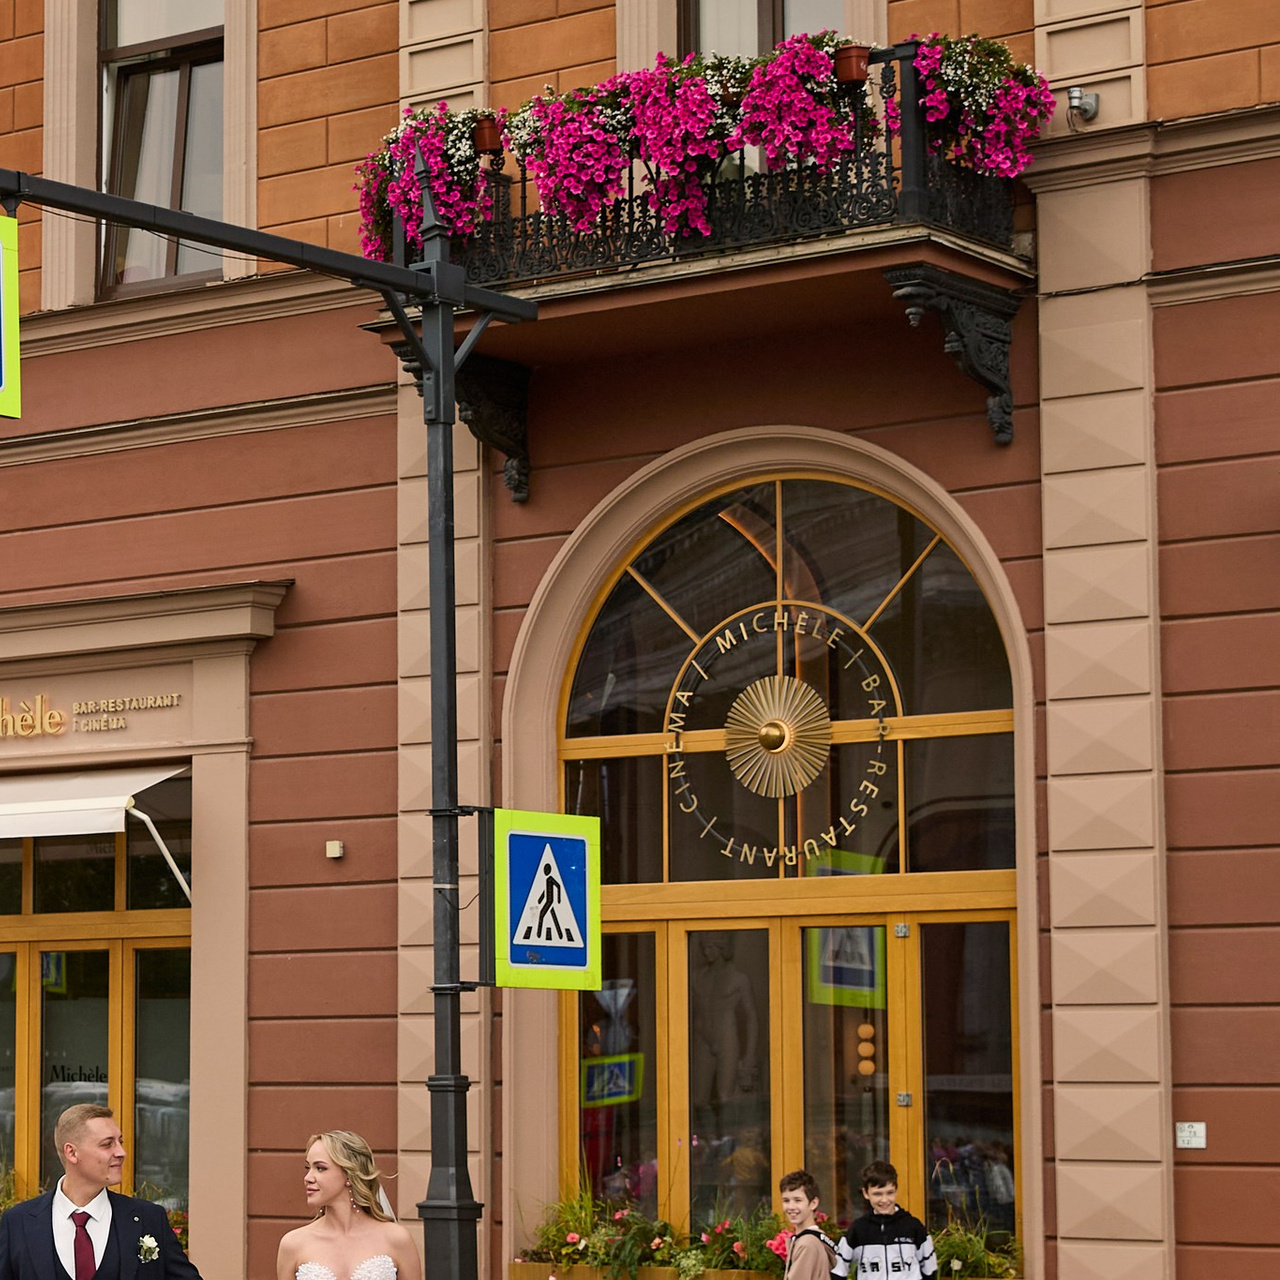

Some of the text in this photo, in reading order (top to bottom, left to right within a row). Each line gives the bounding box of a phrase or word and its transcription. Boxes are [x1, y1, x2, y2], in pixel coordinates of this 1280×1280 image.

[715, 611, 844, 653] MICHÈLE
[72, 693, 181, 715] BAR-RESTAURANT
[664, 690, 698, 813] CINÉMA
[50, 1064, 108, 1083] Michèle
